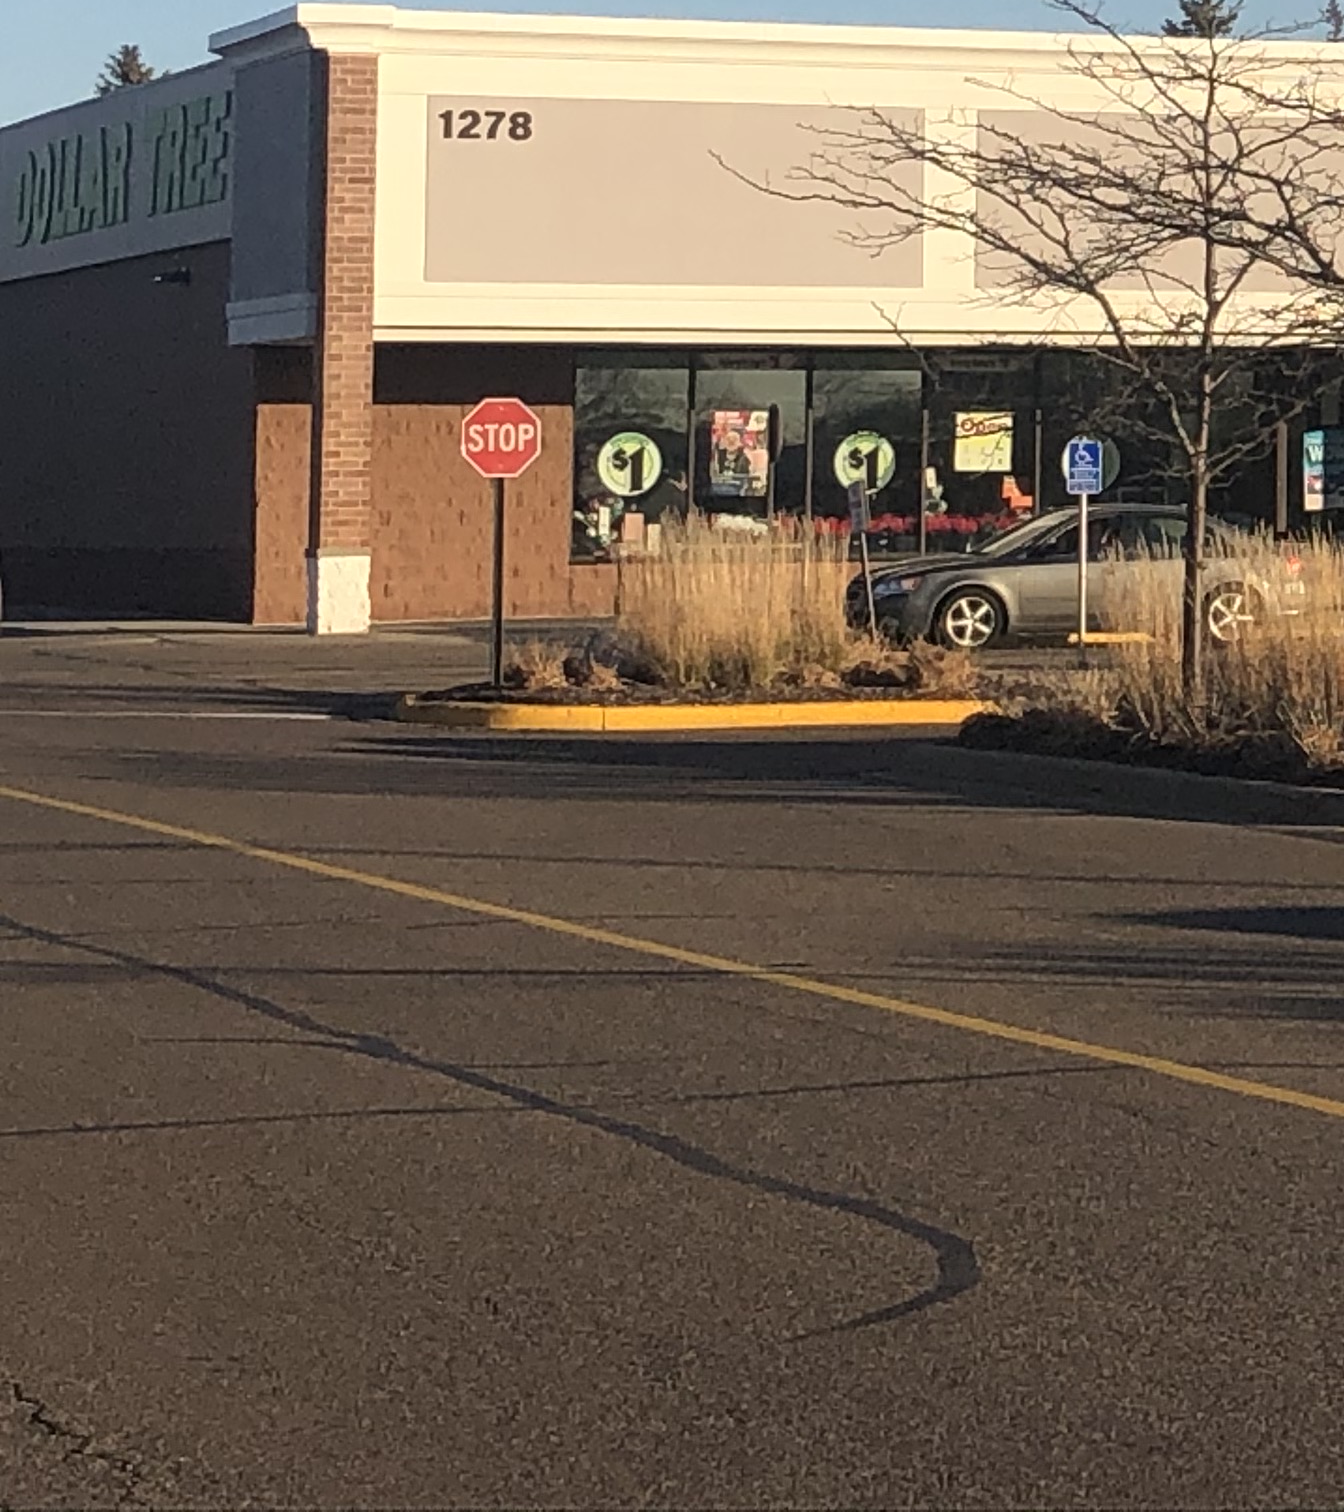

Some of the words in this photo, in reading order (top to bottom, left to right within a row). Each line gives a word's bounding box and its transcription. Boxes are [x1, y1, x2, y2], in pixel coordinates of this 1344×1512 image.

[438, 109, 533, 141] 1278
[15, 121, 133, 249] DOLLAR
[468, 422, 535, 453] STOP
